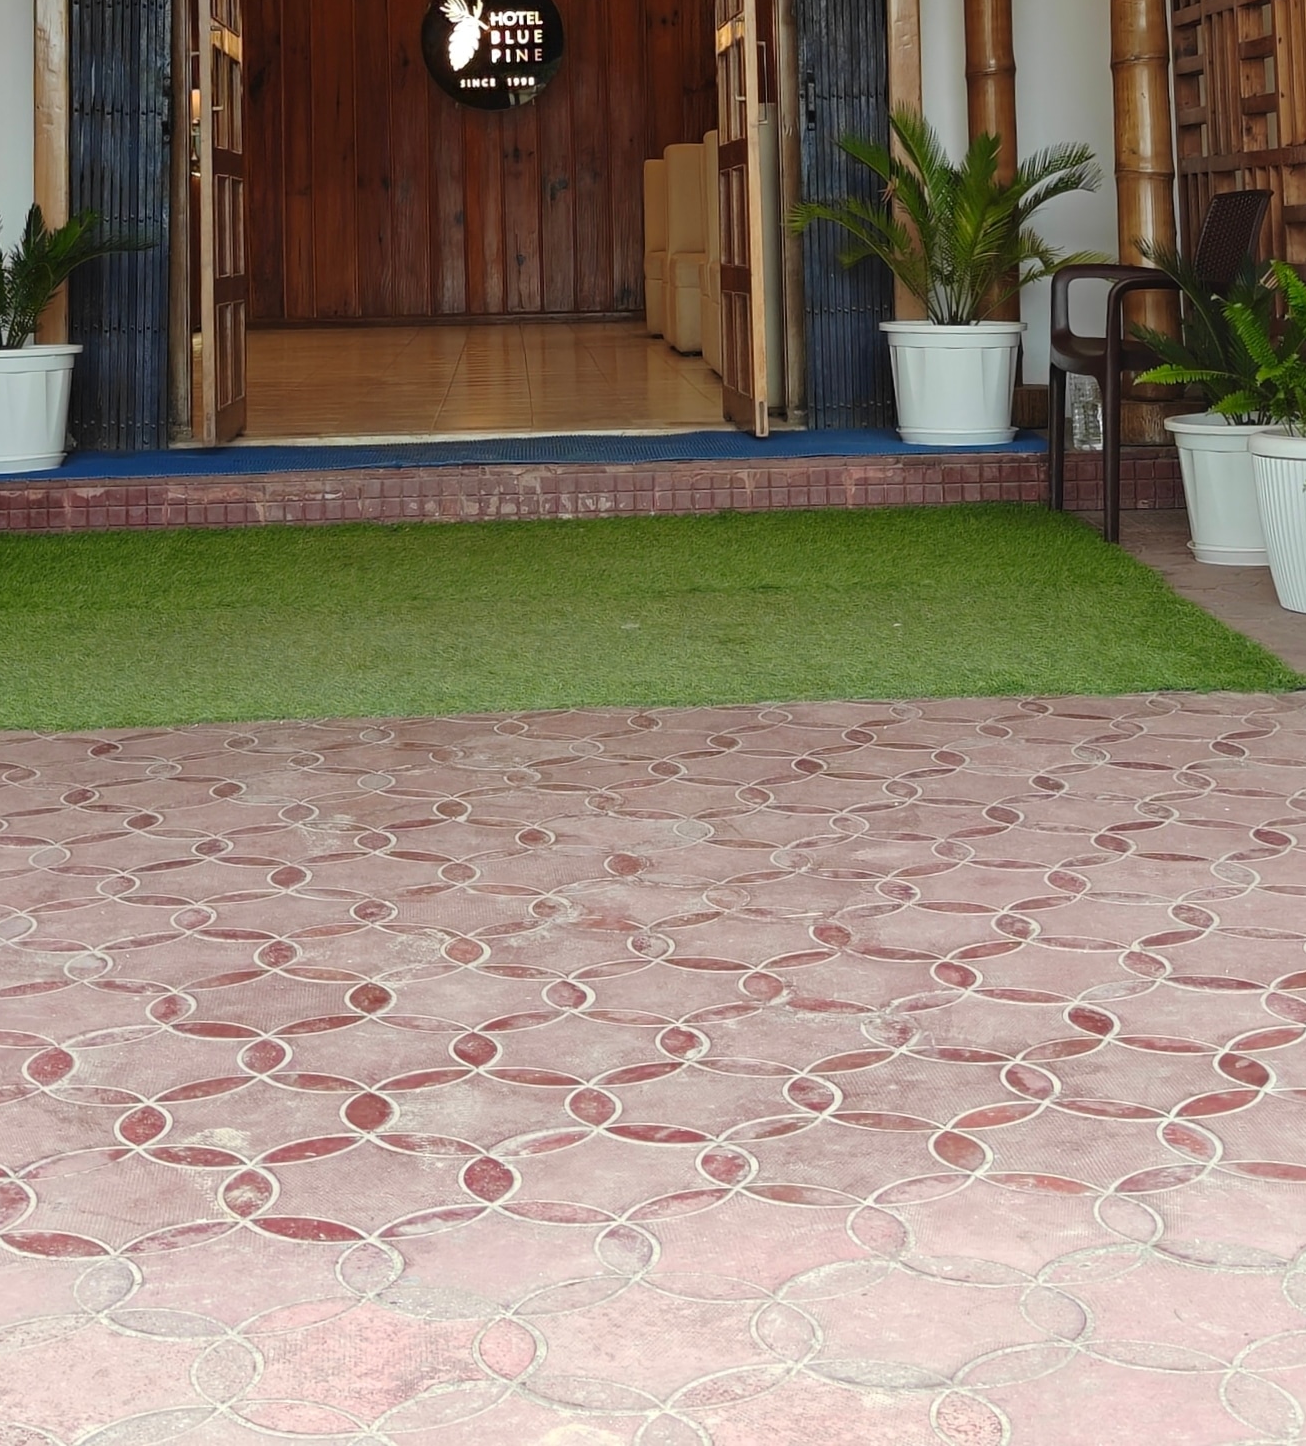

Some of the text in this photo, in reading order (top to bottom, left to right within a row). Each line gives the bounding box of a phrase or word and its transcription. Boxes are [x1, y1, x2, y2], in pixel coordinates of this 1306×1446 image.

[490, 11, 544, 26] HOTEL
[491, 29, 543, 45] BLUE
[491, 48, 543, 63] PINE
[460, 76, 535, 88] SINCE 1998
